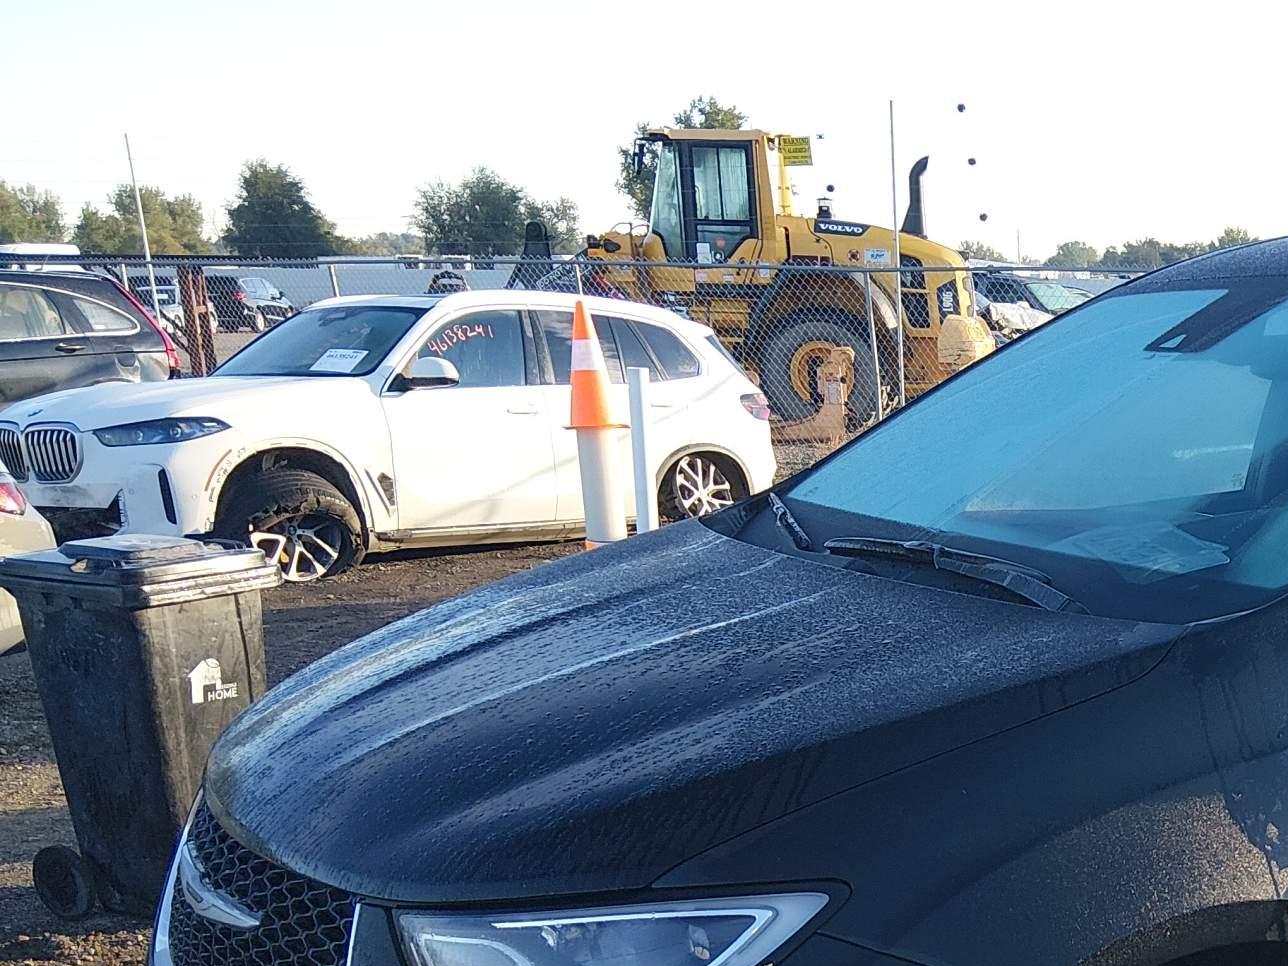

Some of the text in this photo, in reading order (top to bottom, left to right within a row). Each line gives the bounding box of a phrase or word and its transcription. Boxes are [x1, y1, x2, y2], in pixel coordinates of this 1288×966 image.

[819, 223, 863, 233] VOLVO
[427, 324, 494, 356] 46138241
[207, 687, 240, 702] HOME
